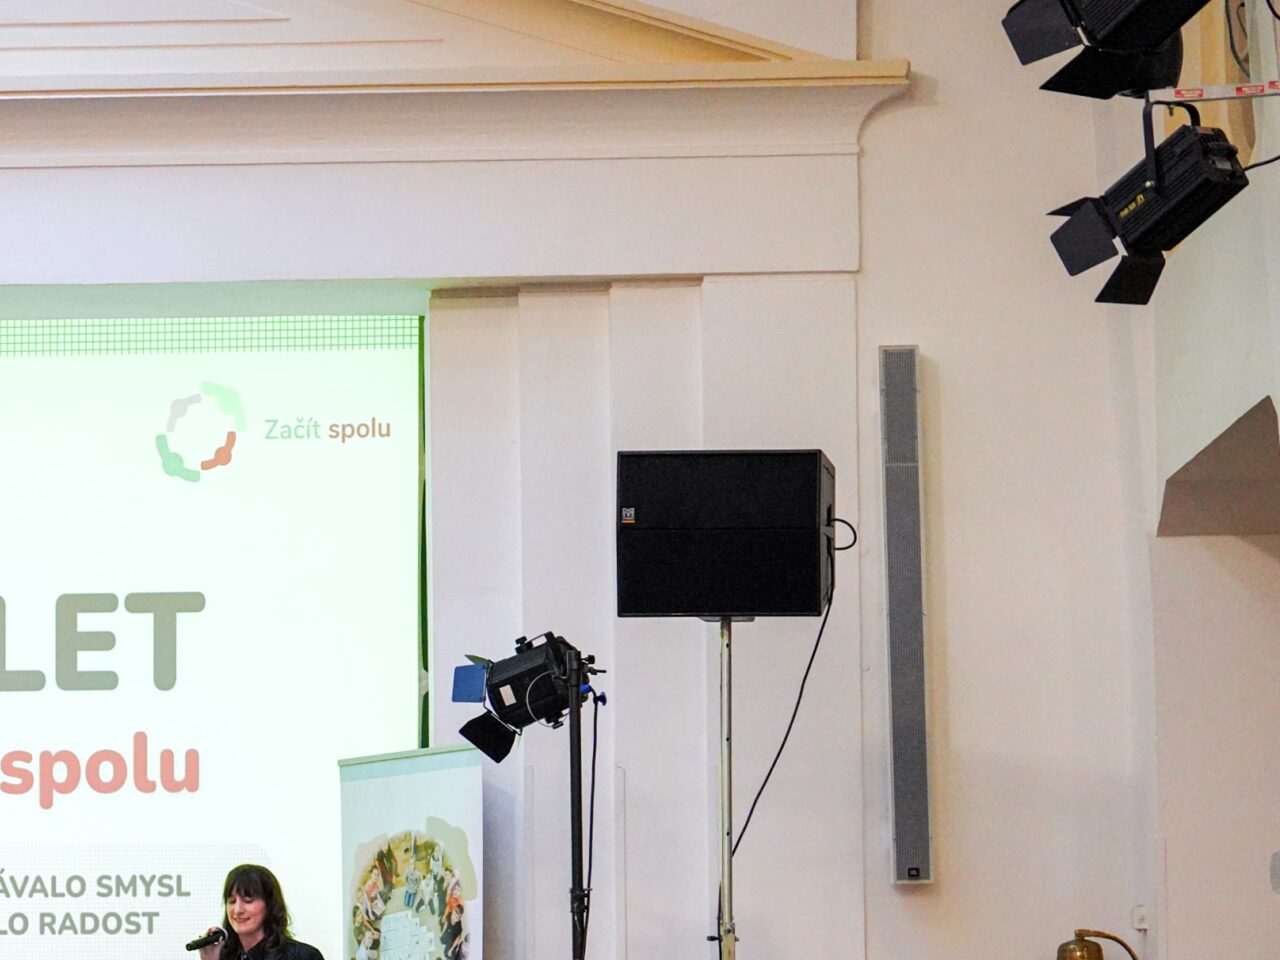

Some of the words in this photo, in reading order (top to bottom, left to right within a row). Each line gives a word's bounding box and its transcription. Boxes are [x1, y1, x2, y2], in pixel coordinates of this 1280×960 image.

[264, 417, 321, 440] Začít
[328, 417, 391, 443] spolu
[0, 731, 201, 810] spolu
[96, 873, 191, 898] SMYSL
[39, 911, 159, 936] RADOST
